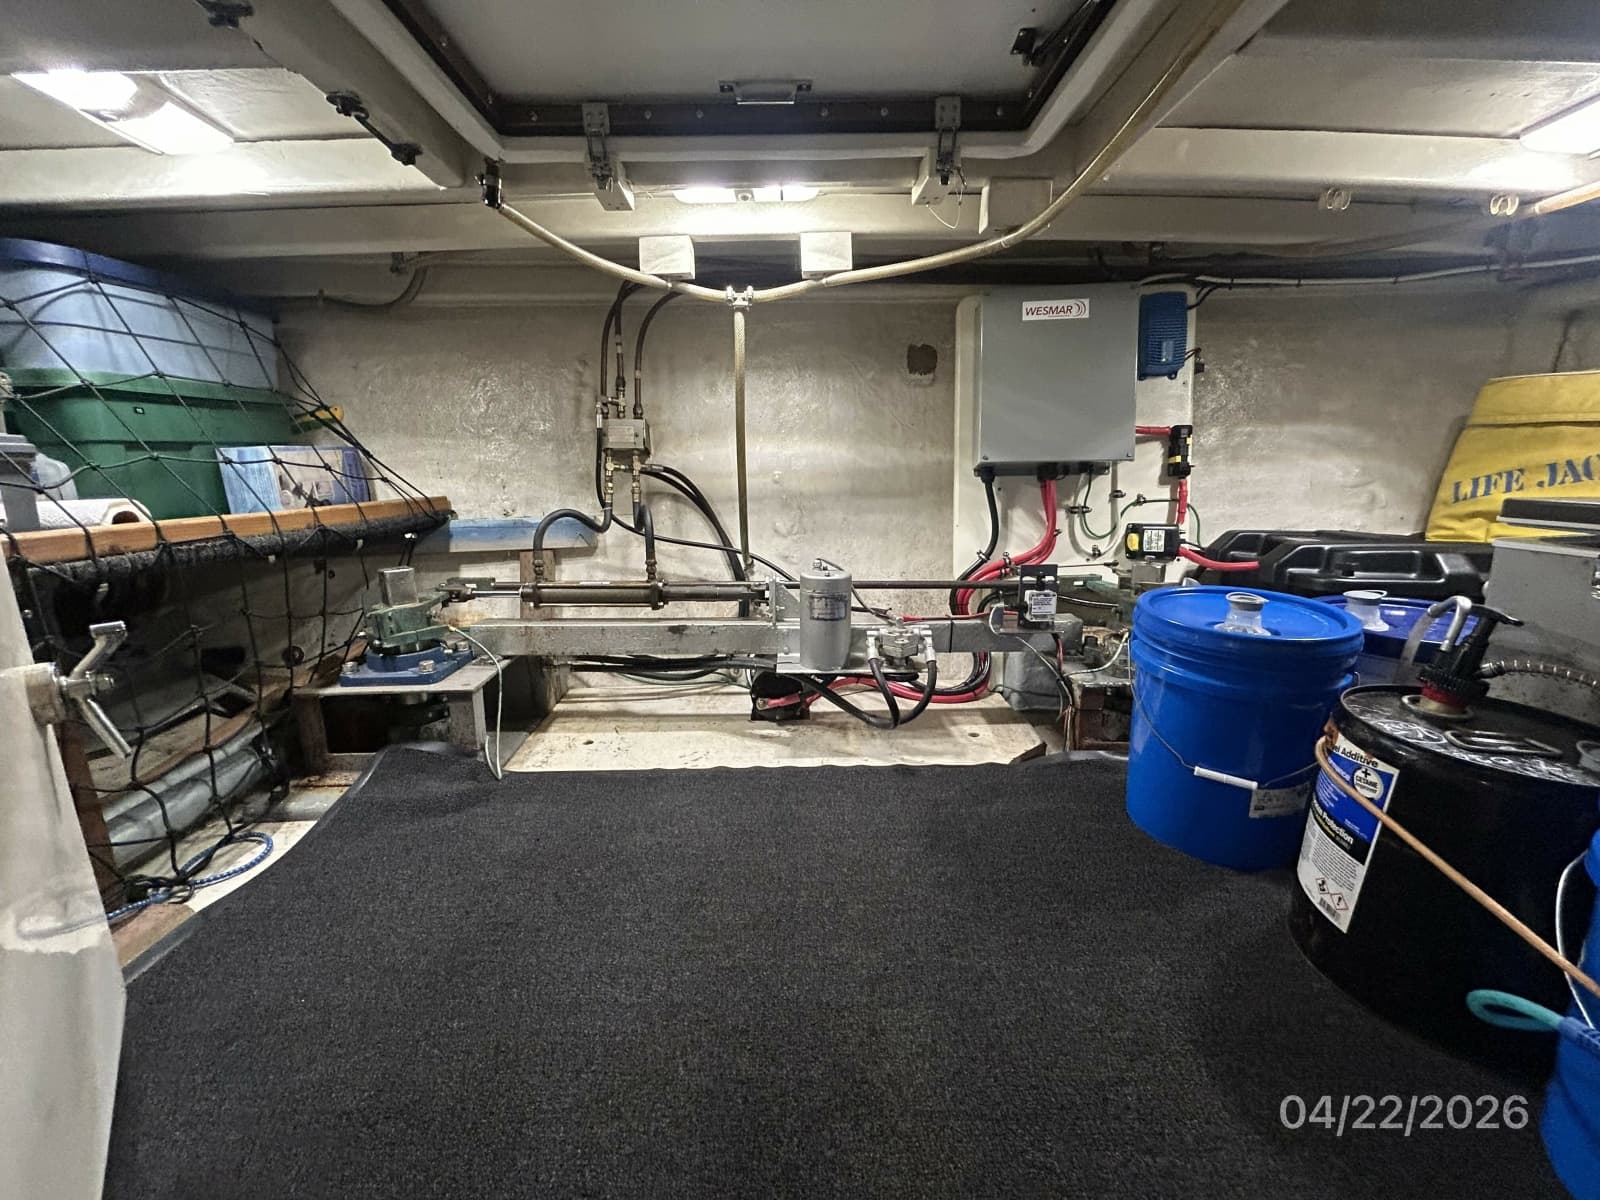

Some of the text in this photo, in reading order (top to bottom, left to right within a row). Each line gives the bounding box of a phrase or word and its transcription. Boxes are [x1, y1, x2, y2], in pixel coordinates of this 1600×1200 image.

[1025, 305, 1073, 316] WESMAR
[1453, 455, 1600, 504] LIFE JAC
[1341, 747, 1379, 768] Additive
[1322, 811, 1354, 844] Protection
